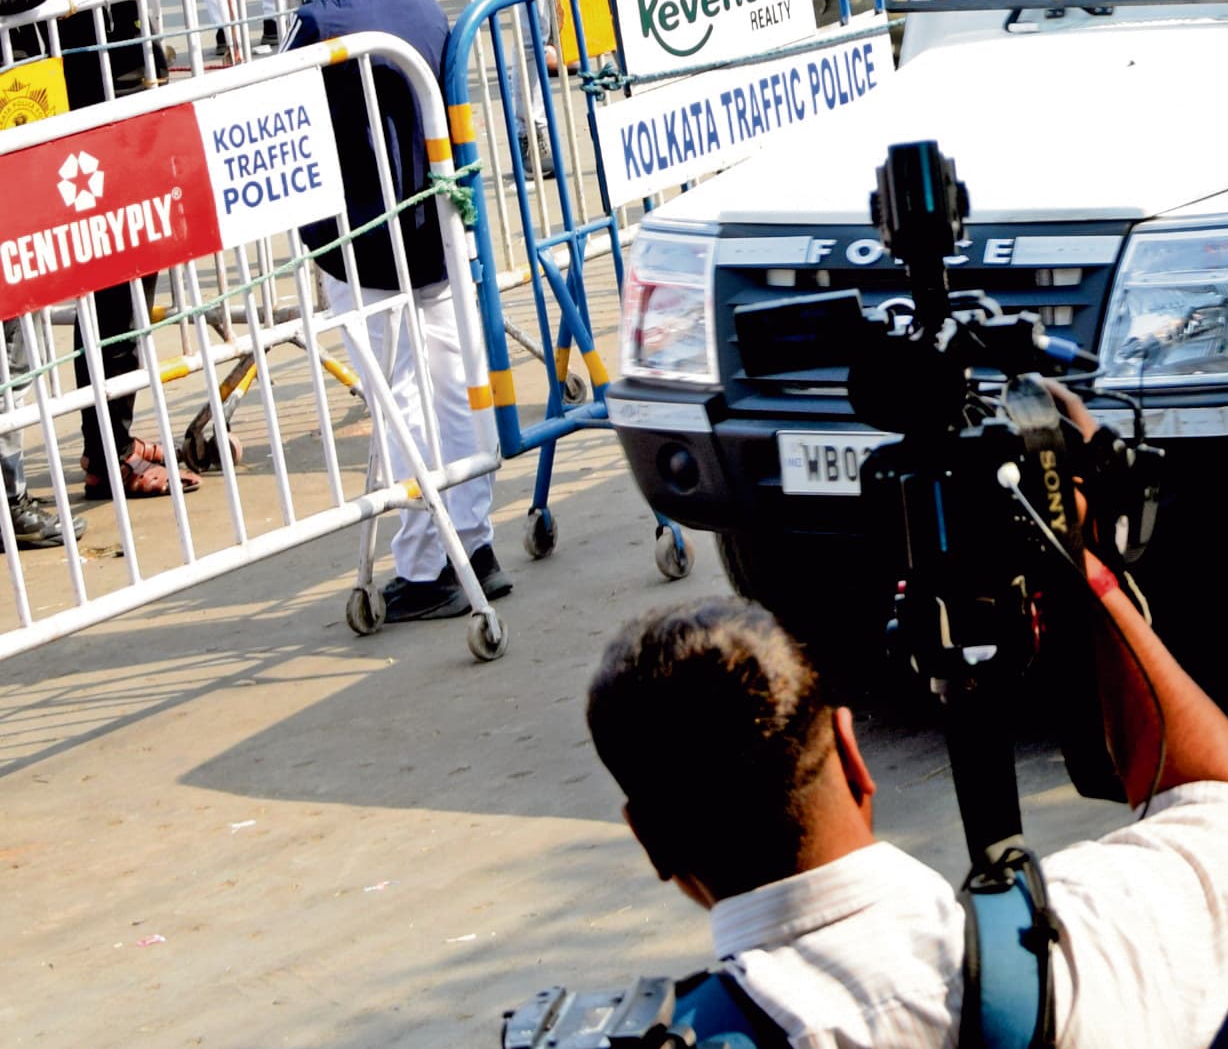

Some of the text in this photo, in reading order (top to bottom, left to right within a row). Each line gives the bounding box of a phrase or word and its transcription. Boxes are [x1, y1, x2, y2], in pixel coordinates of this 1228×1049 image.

[750, 0, 792, 31] REALTY
[212, 105, 312, 153] KOLKATA
[620, 43, 878, 181] KOLKATA TRAFFIC POLICE
[223, 135, 313, 181] TRAFFIC
[223, 162, 323, 214] POLICE
[1040, 450, 1068, 532] SONY
